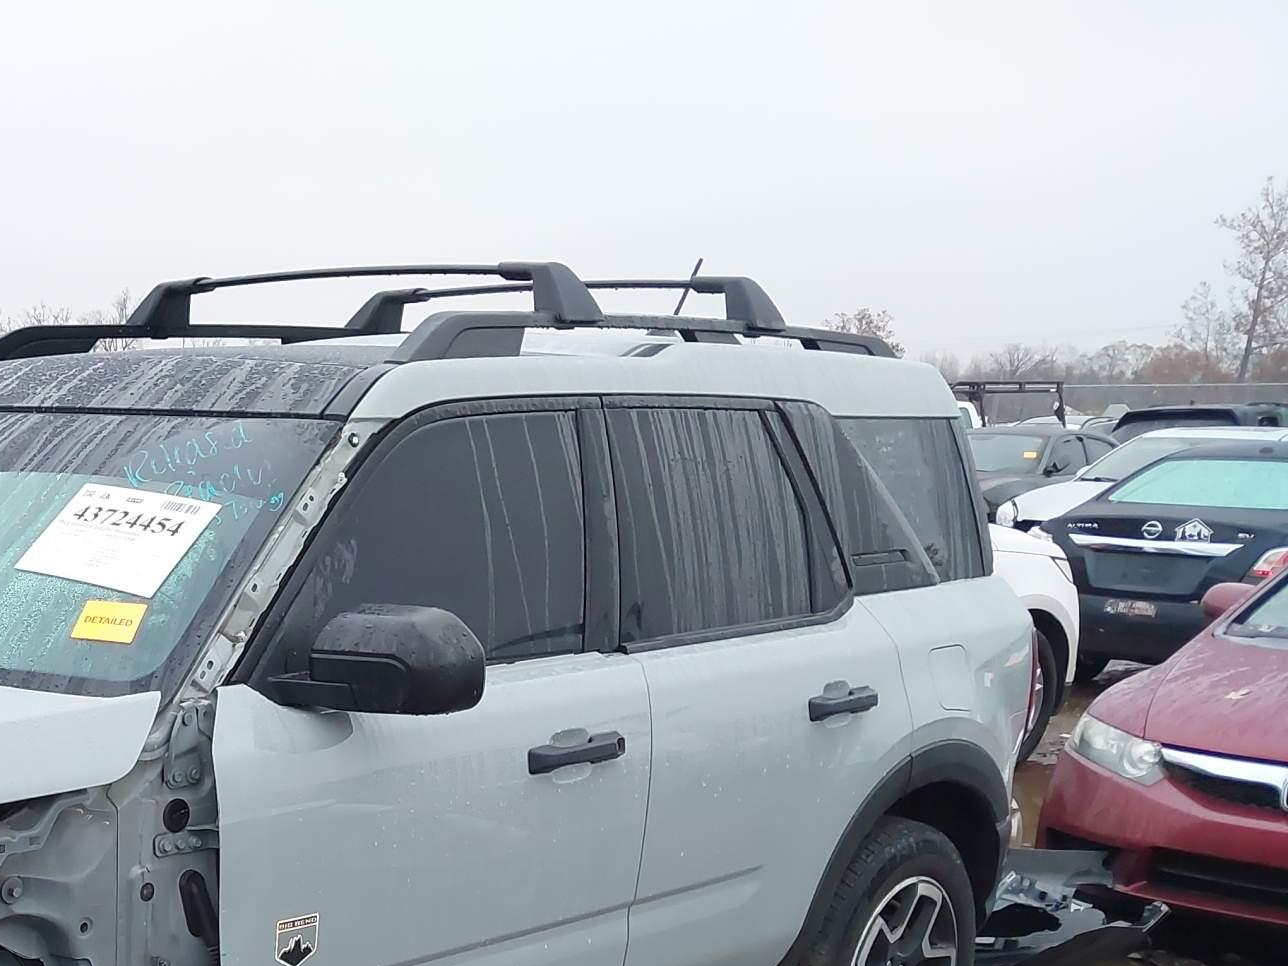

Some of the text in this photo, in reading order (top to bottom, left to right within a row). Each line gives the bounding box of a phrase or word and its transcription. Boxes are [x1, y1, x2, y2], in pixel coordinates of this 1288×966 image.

[73, 505, 185, 536] 43724454
[84, 615, 133, 627] DETAILED
[279, 917, 317, 930] BIG BEND
